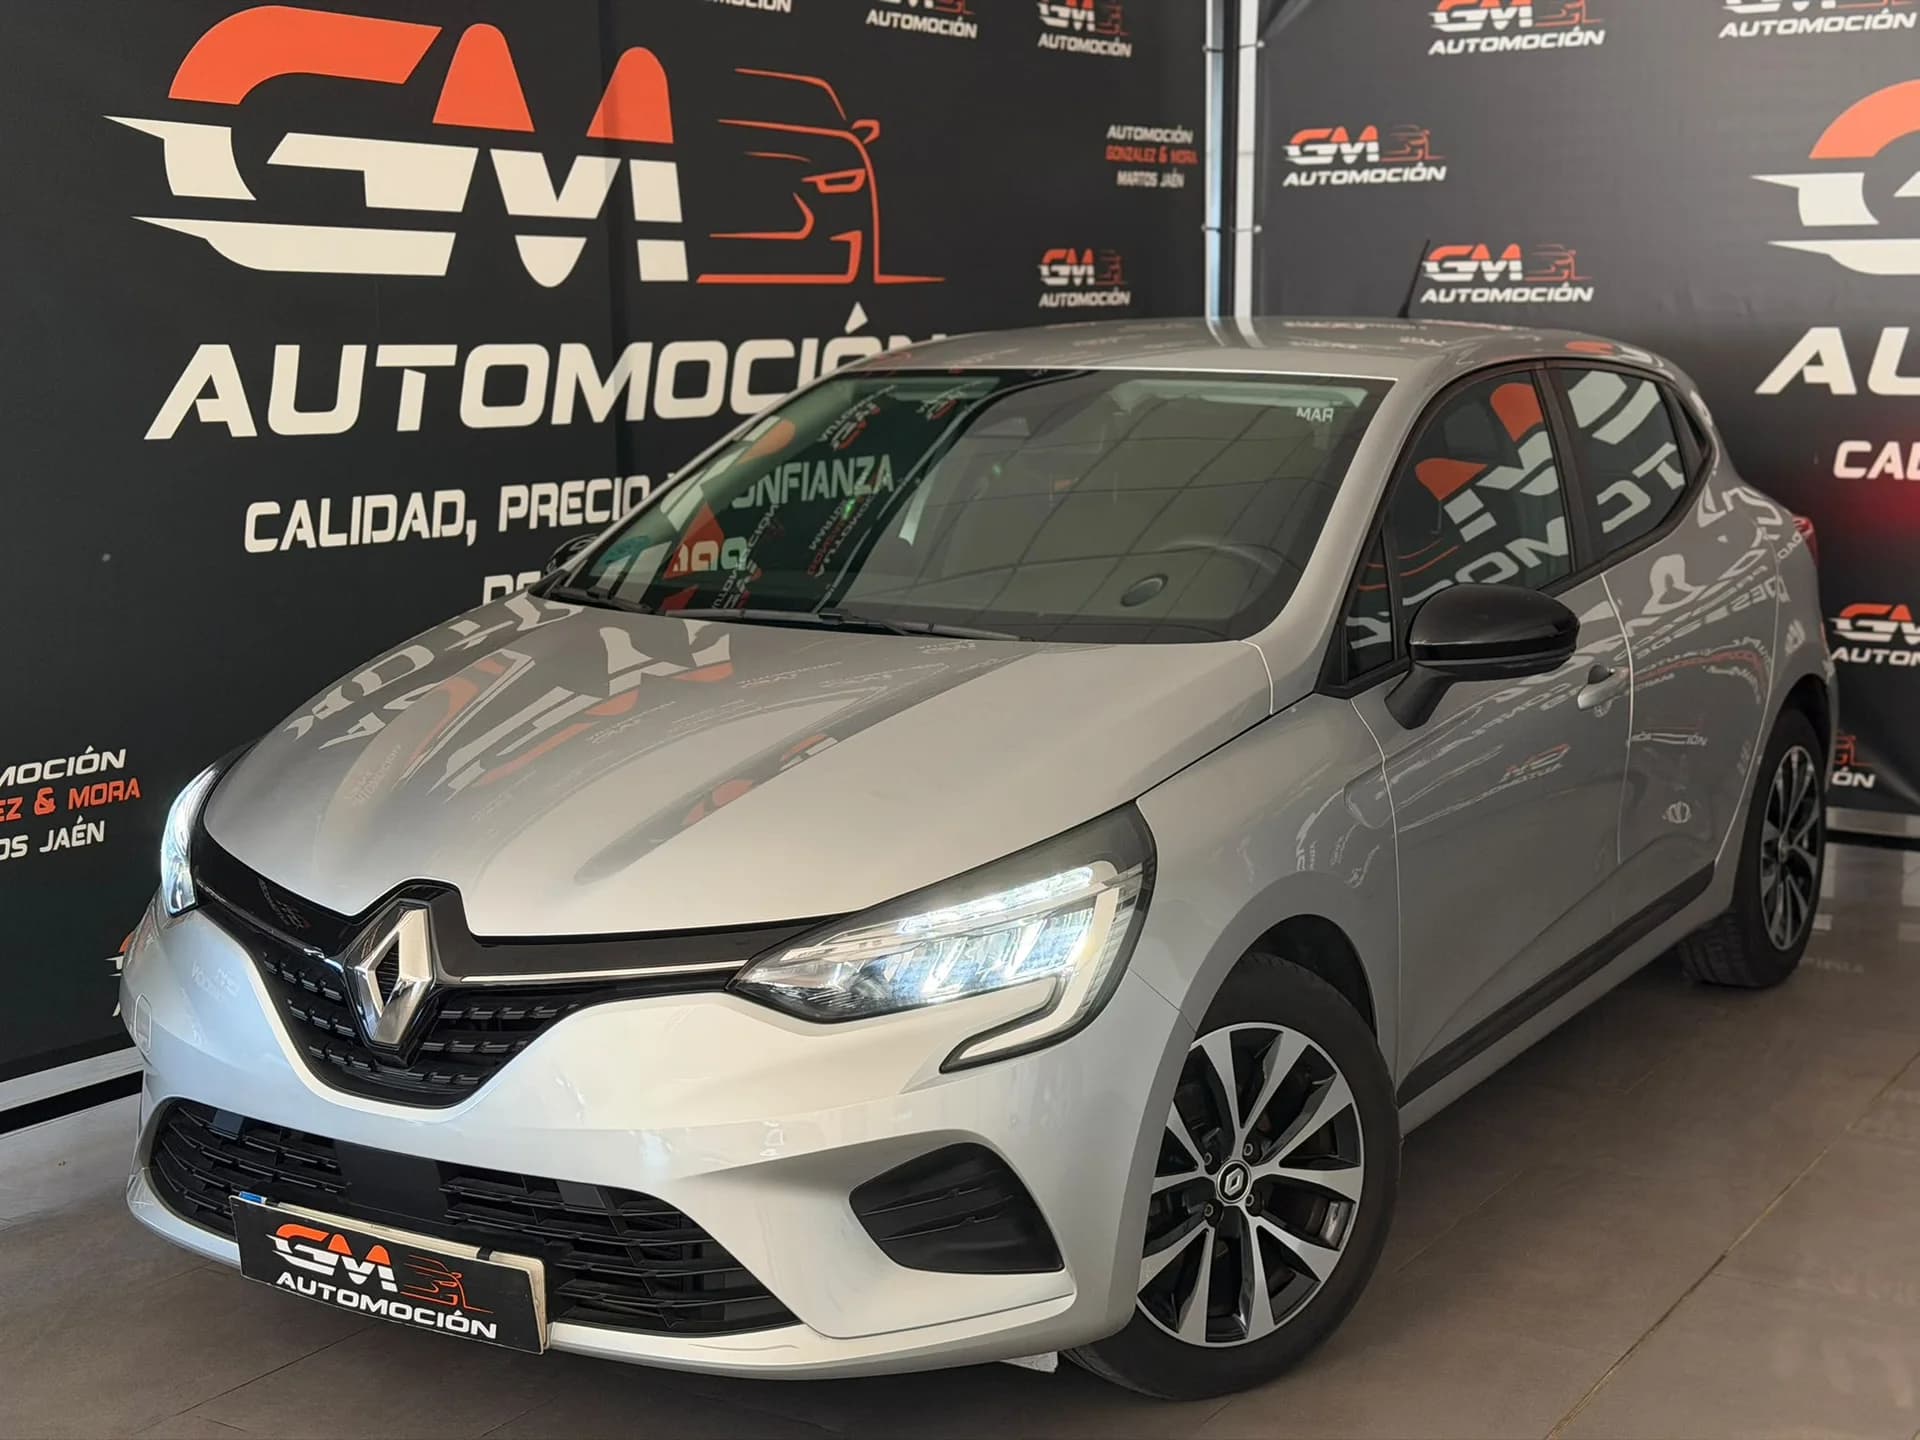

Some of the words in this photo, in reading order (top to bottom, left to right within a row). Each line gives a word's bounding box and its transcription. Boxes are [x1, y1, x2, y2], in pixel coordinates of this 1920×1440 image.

[865, 8, 978, 39] AUTOMOCIÓN
[1428, 25, 1606, 56] AUTOMOCIÓN
[1718, 7, 1918, 39] AUTOMOCIÓN
[1037, 32, 1133, 58] AUTOMOCIÓN
[102, 5, 688, 287] GM
[1105, 124, 1194, 144] AUTOMOCIÓN
[1282, 124, 1381, 166] GM
[1282, 161, 1448, 187] AUTOMOCIÓN
[1037, 247, 1096, 286] GM
[1421, 243, 1523, 282] GM
[1038, 286, 1132, 308] AUTOMOCIÓN
[1420, 280, 1594, 304] AUTOMOCIÓN
[244, 489, 478, 553] CALIDAD,
[34, 786, 57, 816] &
[68, 777, 141, 811] MORA
[39, 814, 105, 853] JAÉN
[265, 1223, 398, 1293] GM
[276, 1271, 497, 1340] AUTOMOCIÓN
